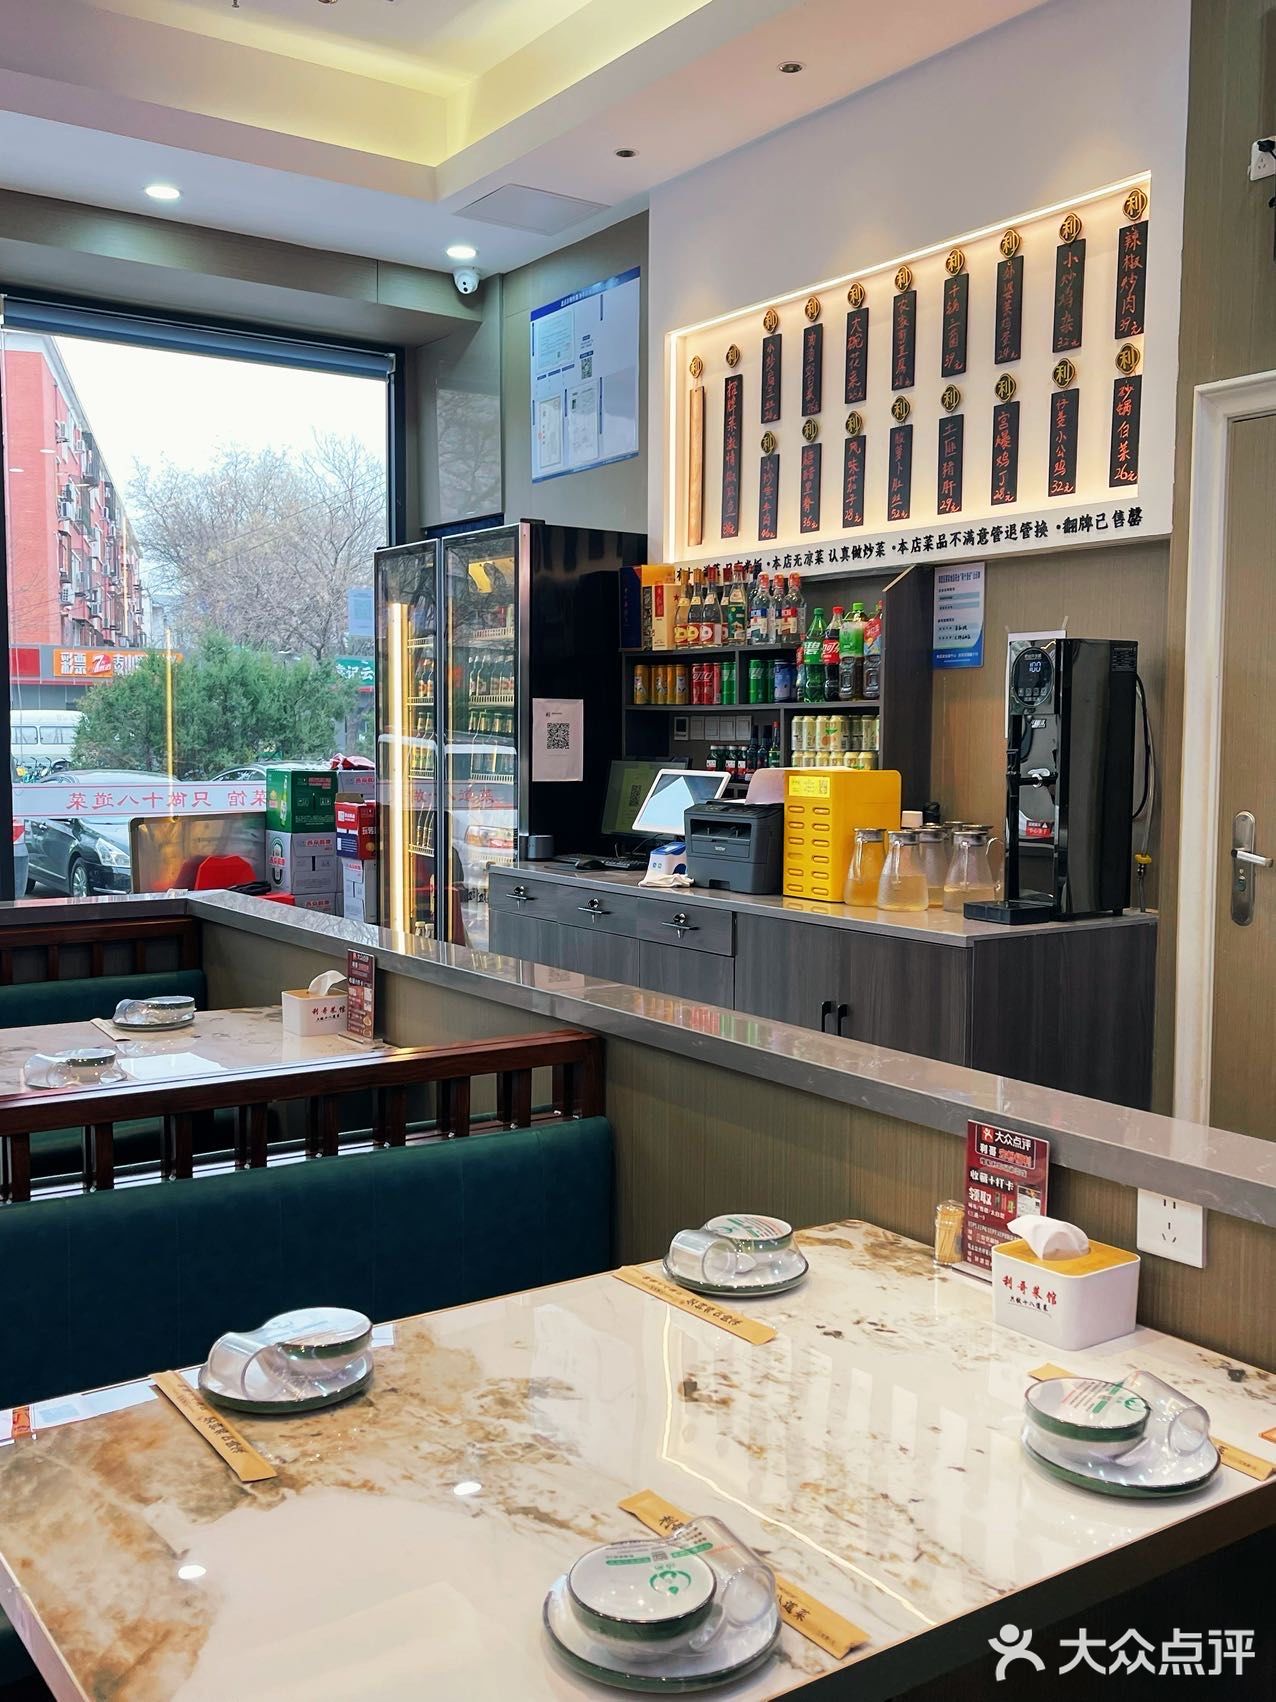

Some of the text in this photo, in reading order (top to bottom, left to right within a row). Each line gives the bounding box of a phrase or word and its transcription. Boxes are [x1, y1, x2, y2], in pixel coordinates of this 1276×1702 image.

[1119, 229, 1144, 315] 辣椒炒肉
[941, 423, 958, 497] 土匪猪肝
[828, 541, 886, 564] 认真做炒菜
[897, 519, 1049, 555] 本店菜品不满意管退管换
[1062, 506, 1144, 534] 翻牌已售罄
[60, 651, 87, 675] 彩票
[1029, 661, 1042, 673] 100
[979, 1142, 997, 1157] 利哥
[995, 1130, 1032, 1152] 大众点评
[1002, 1275, 1057, 1306] 利哥菜馆
